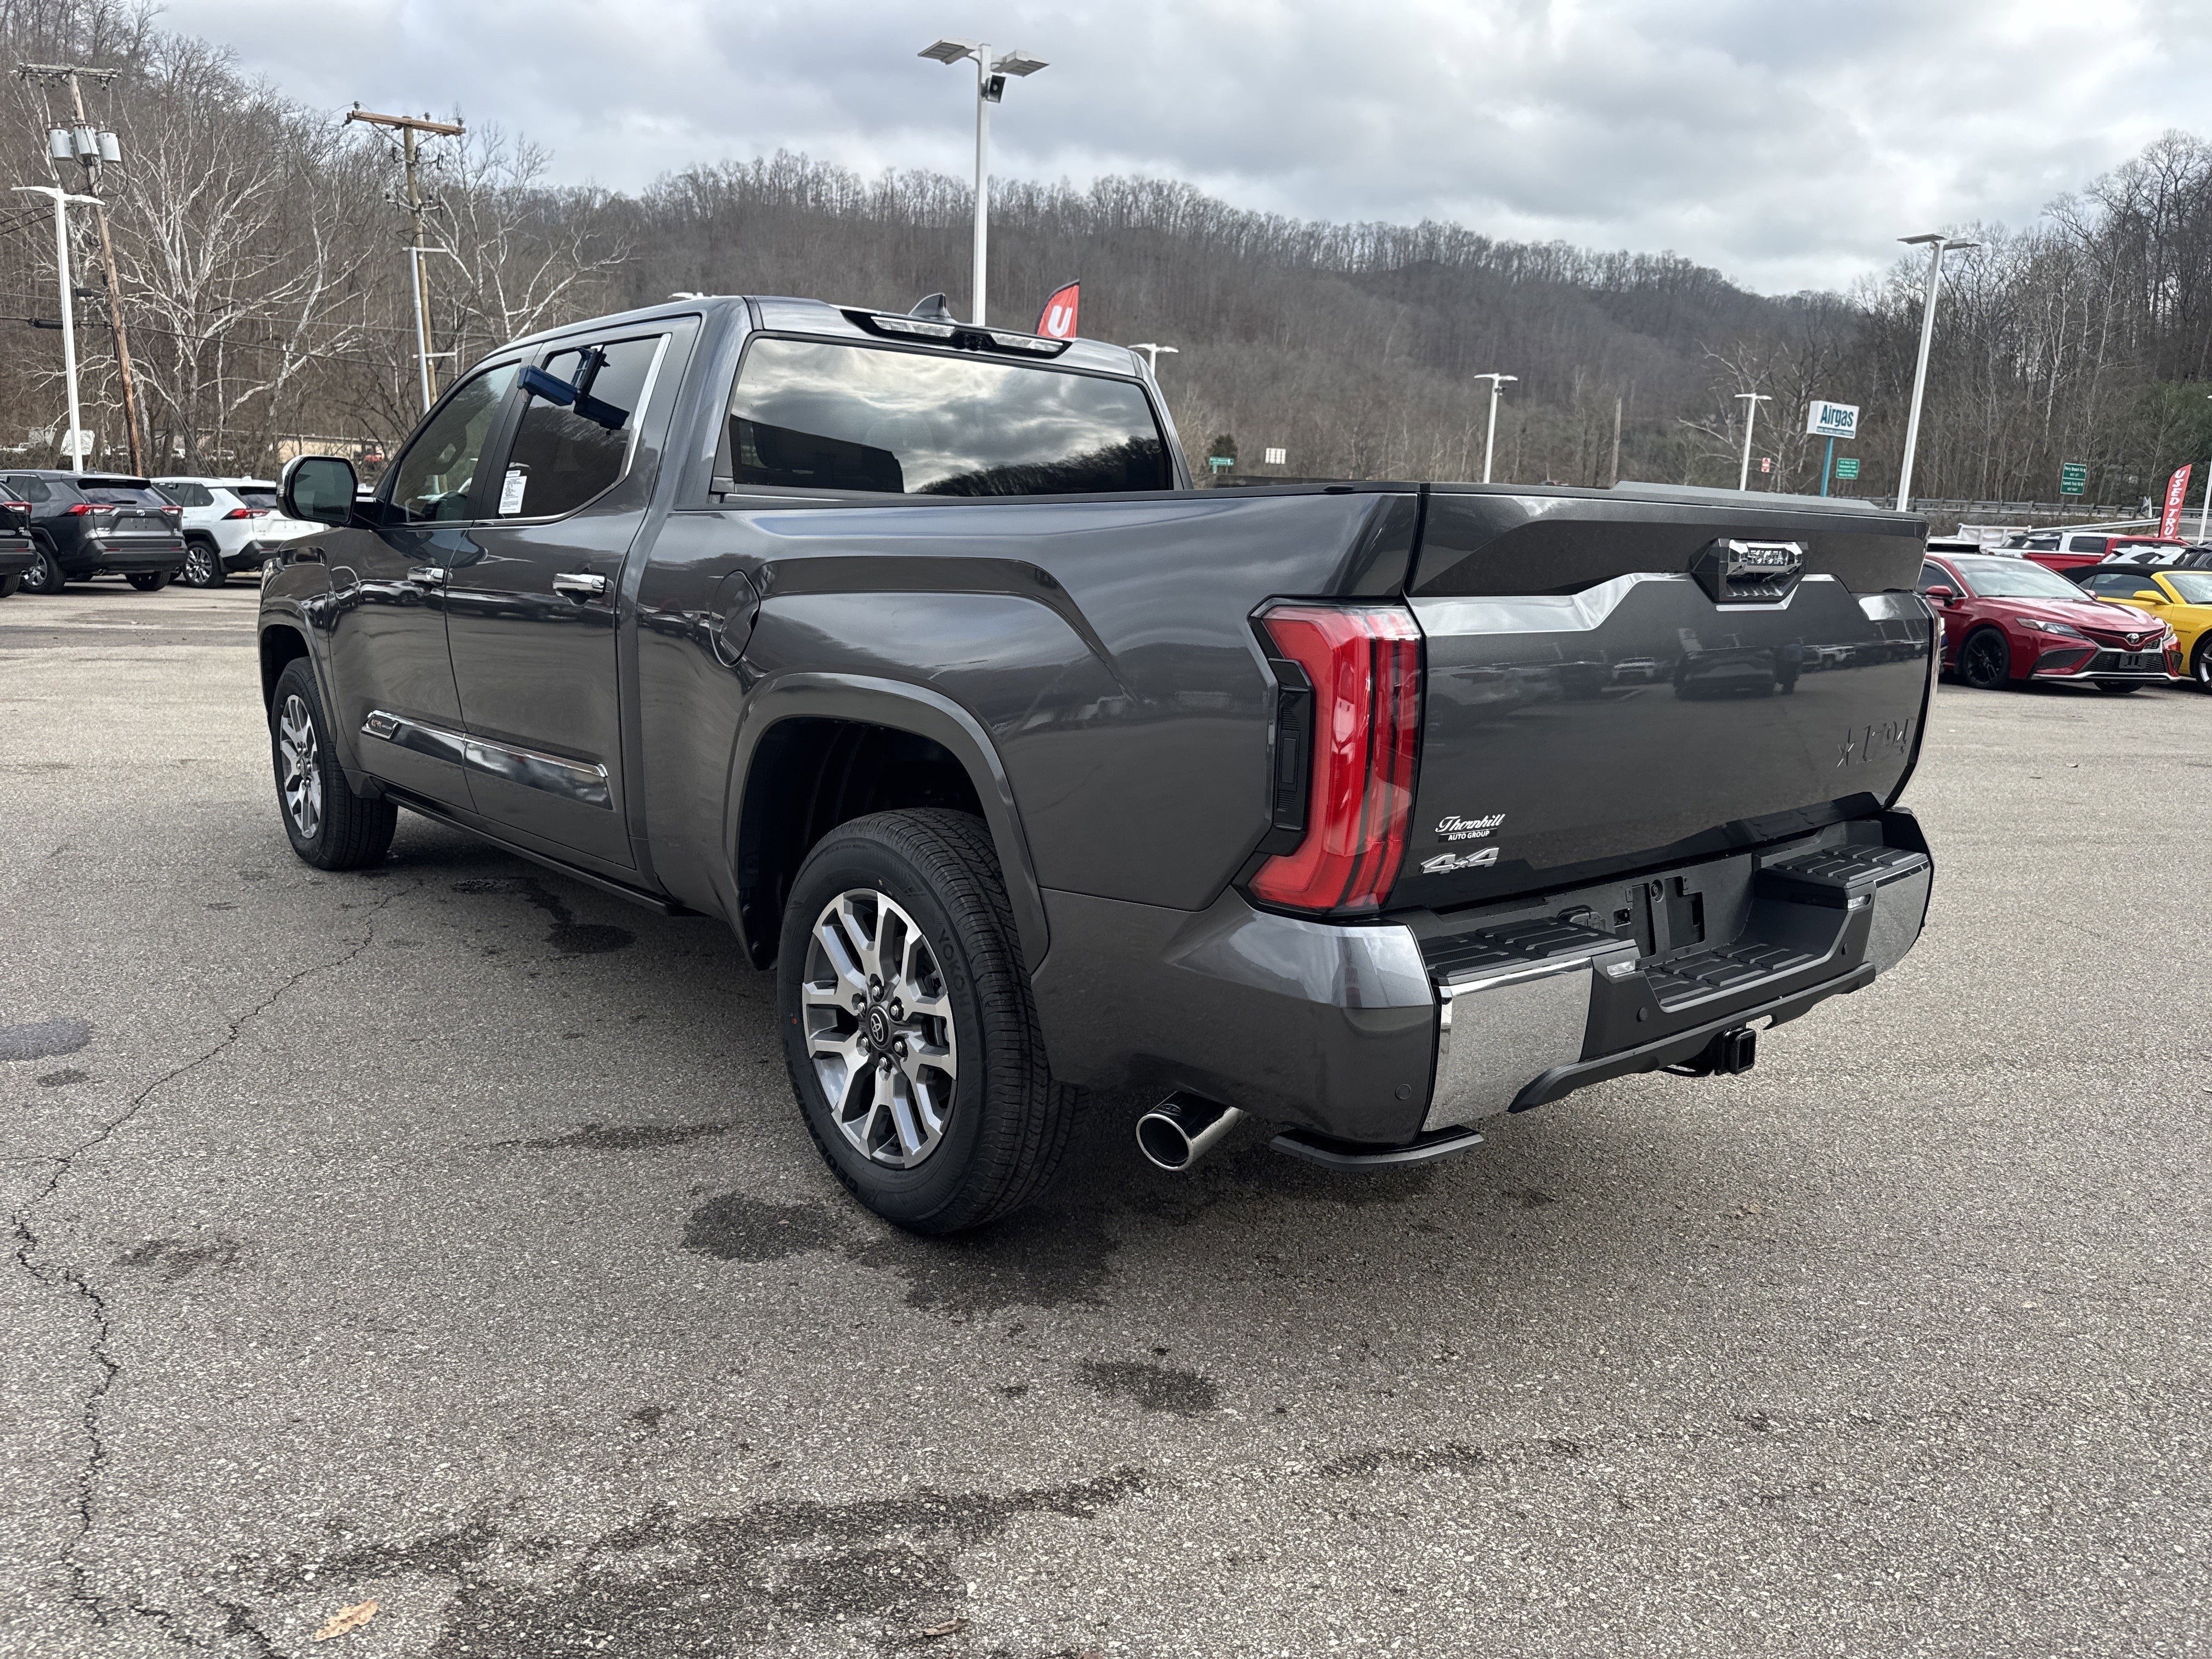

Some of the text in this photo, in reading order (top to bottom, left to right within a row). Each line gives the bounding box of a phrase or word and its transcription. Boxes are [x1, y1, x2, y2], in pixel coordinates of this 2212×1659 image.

[1047, 305, 1073, 337] U
[1820, 405, 1854, 427] Airgas
[2169, 470, 2186, 506] USED
[1435, 814, 1506, 832] Thornhill
[1467, 830, 1490, 839] GROUP
